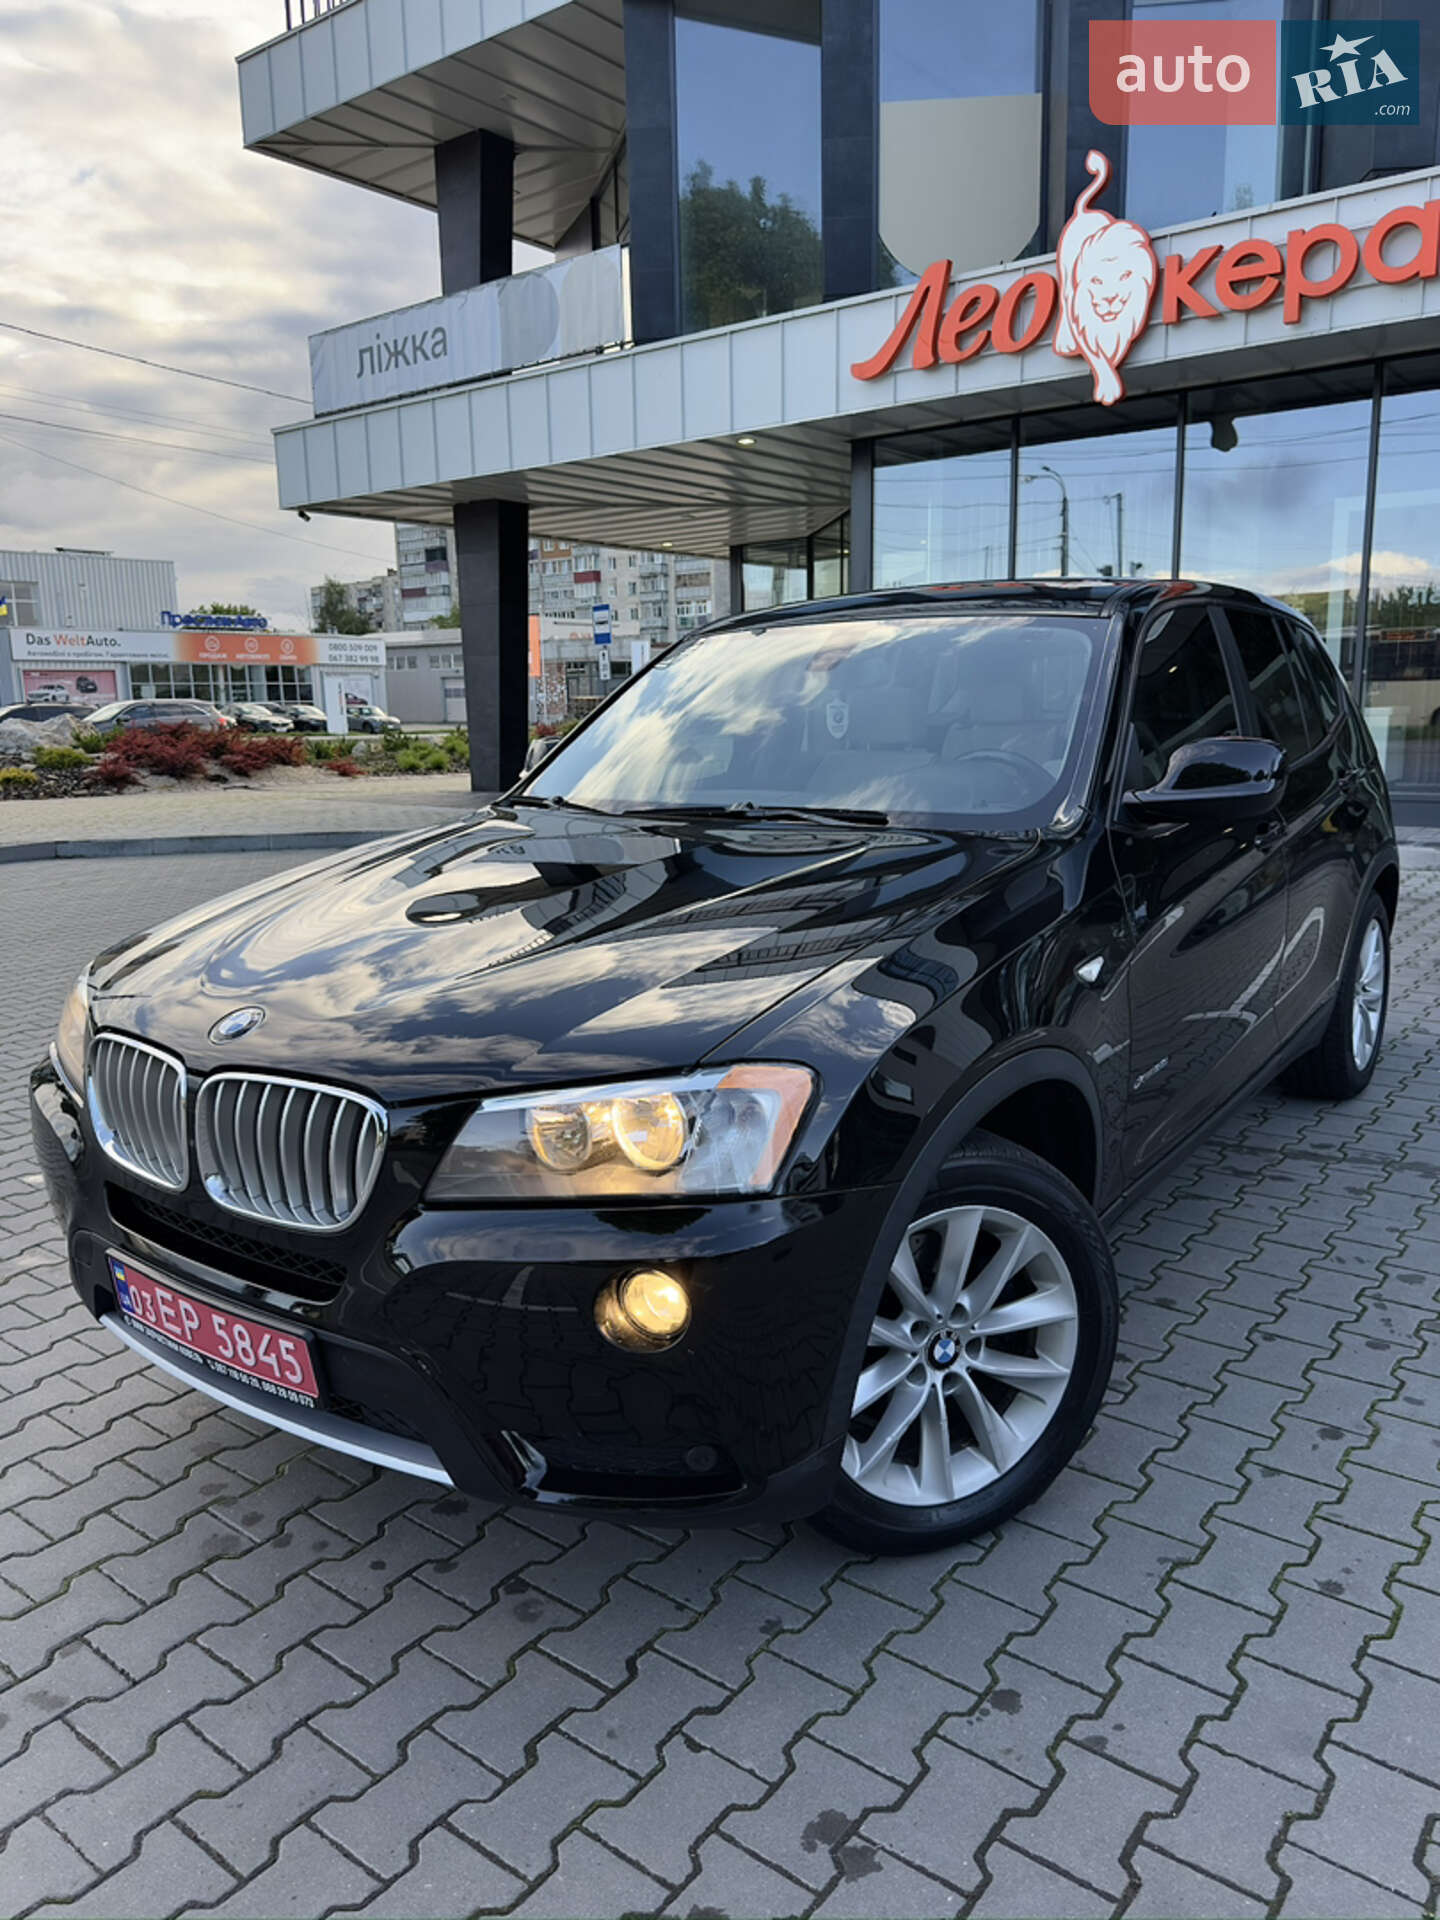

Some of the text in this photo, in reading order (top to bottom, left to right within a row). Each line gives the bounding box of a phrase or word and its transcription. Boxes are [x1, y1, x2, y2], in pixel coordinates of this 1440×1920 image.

[356, 325, 448, 380] ліжка
[26, 633, 51, 646] Das
[211, 1313, 303, 1384] 5845
